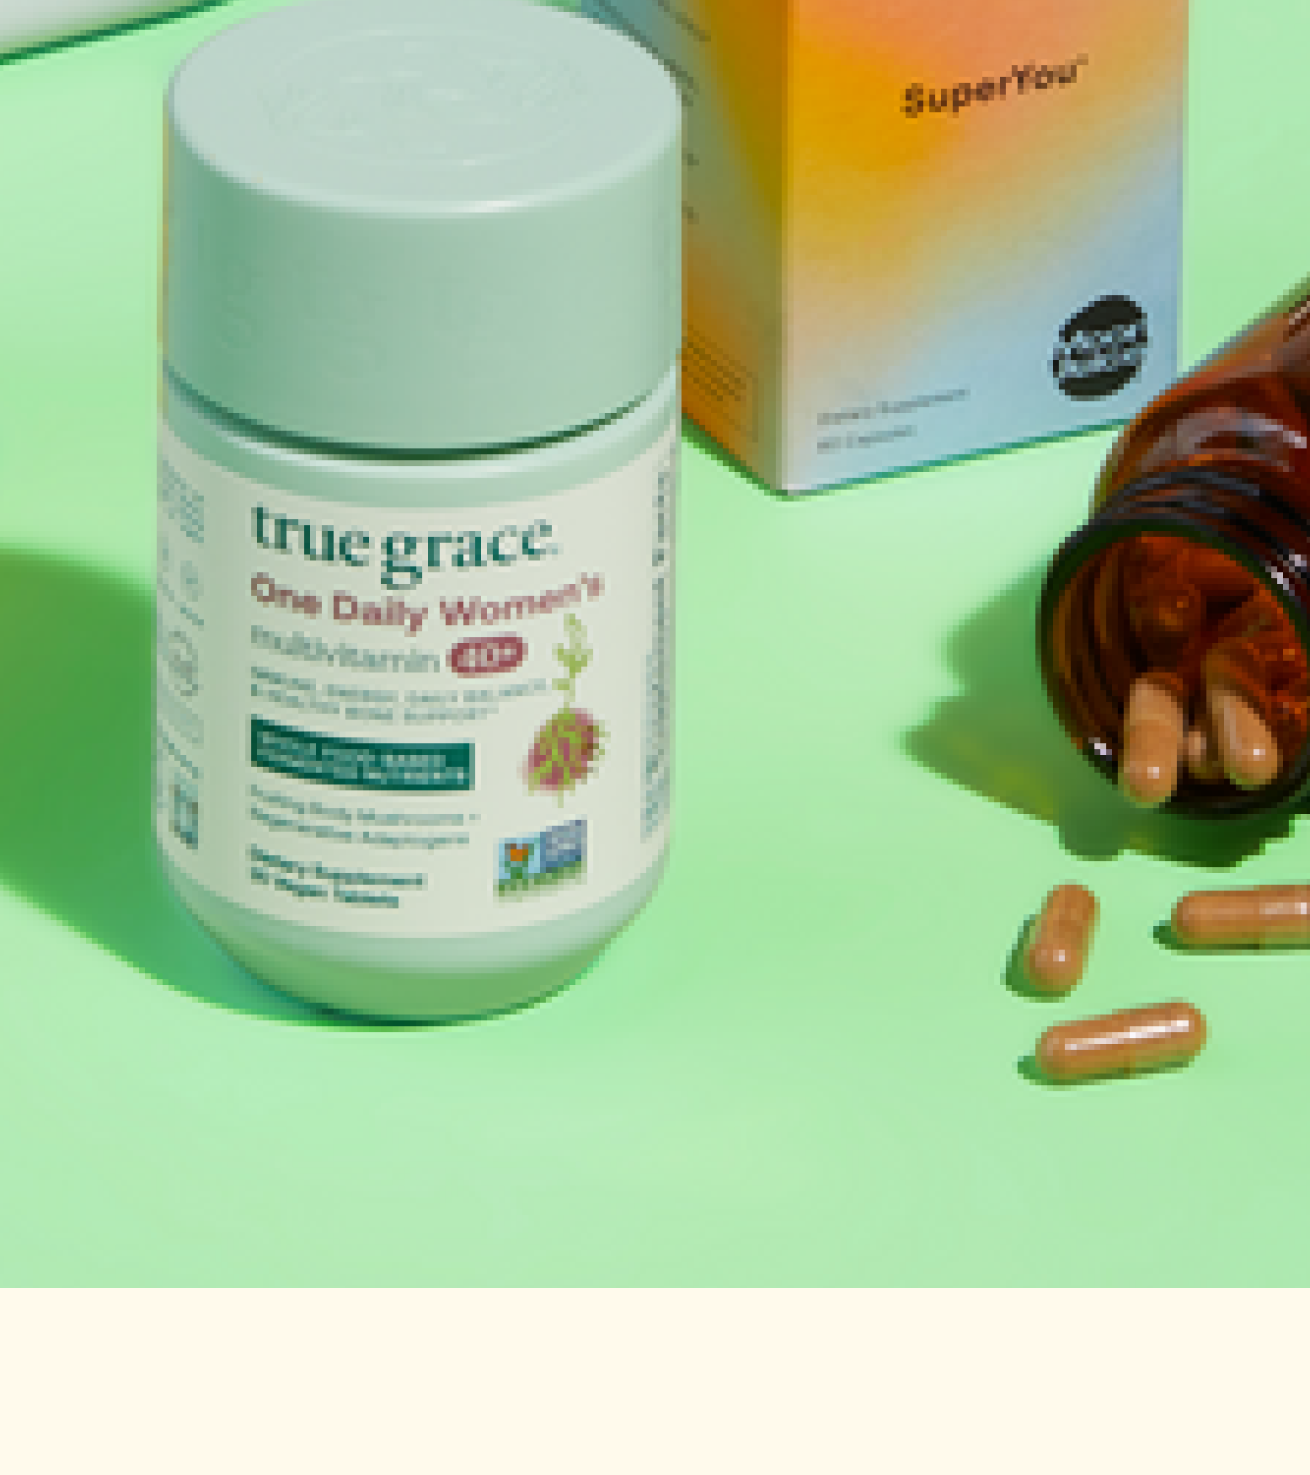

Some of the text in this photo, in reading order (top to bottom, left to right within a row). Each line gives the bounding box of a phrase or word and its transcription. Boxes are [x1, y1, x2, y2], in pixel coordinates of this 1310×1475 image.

[901, 58, 1083, 118] SuperYou
[250, 503, 370, 568] true
[249, 572, 605, 637] One Daily Women's
[250, 624, 441, 675] multivitamin
